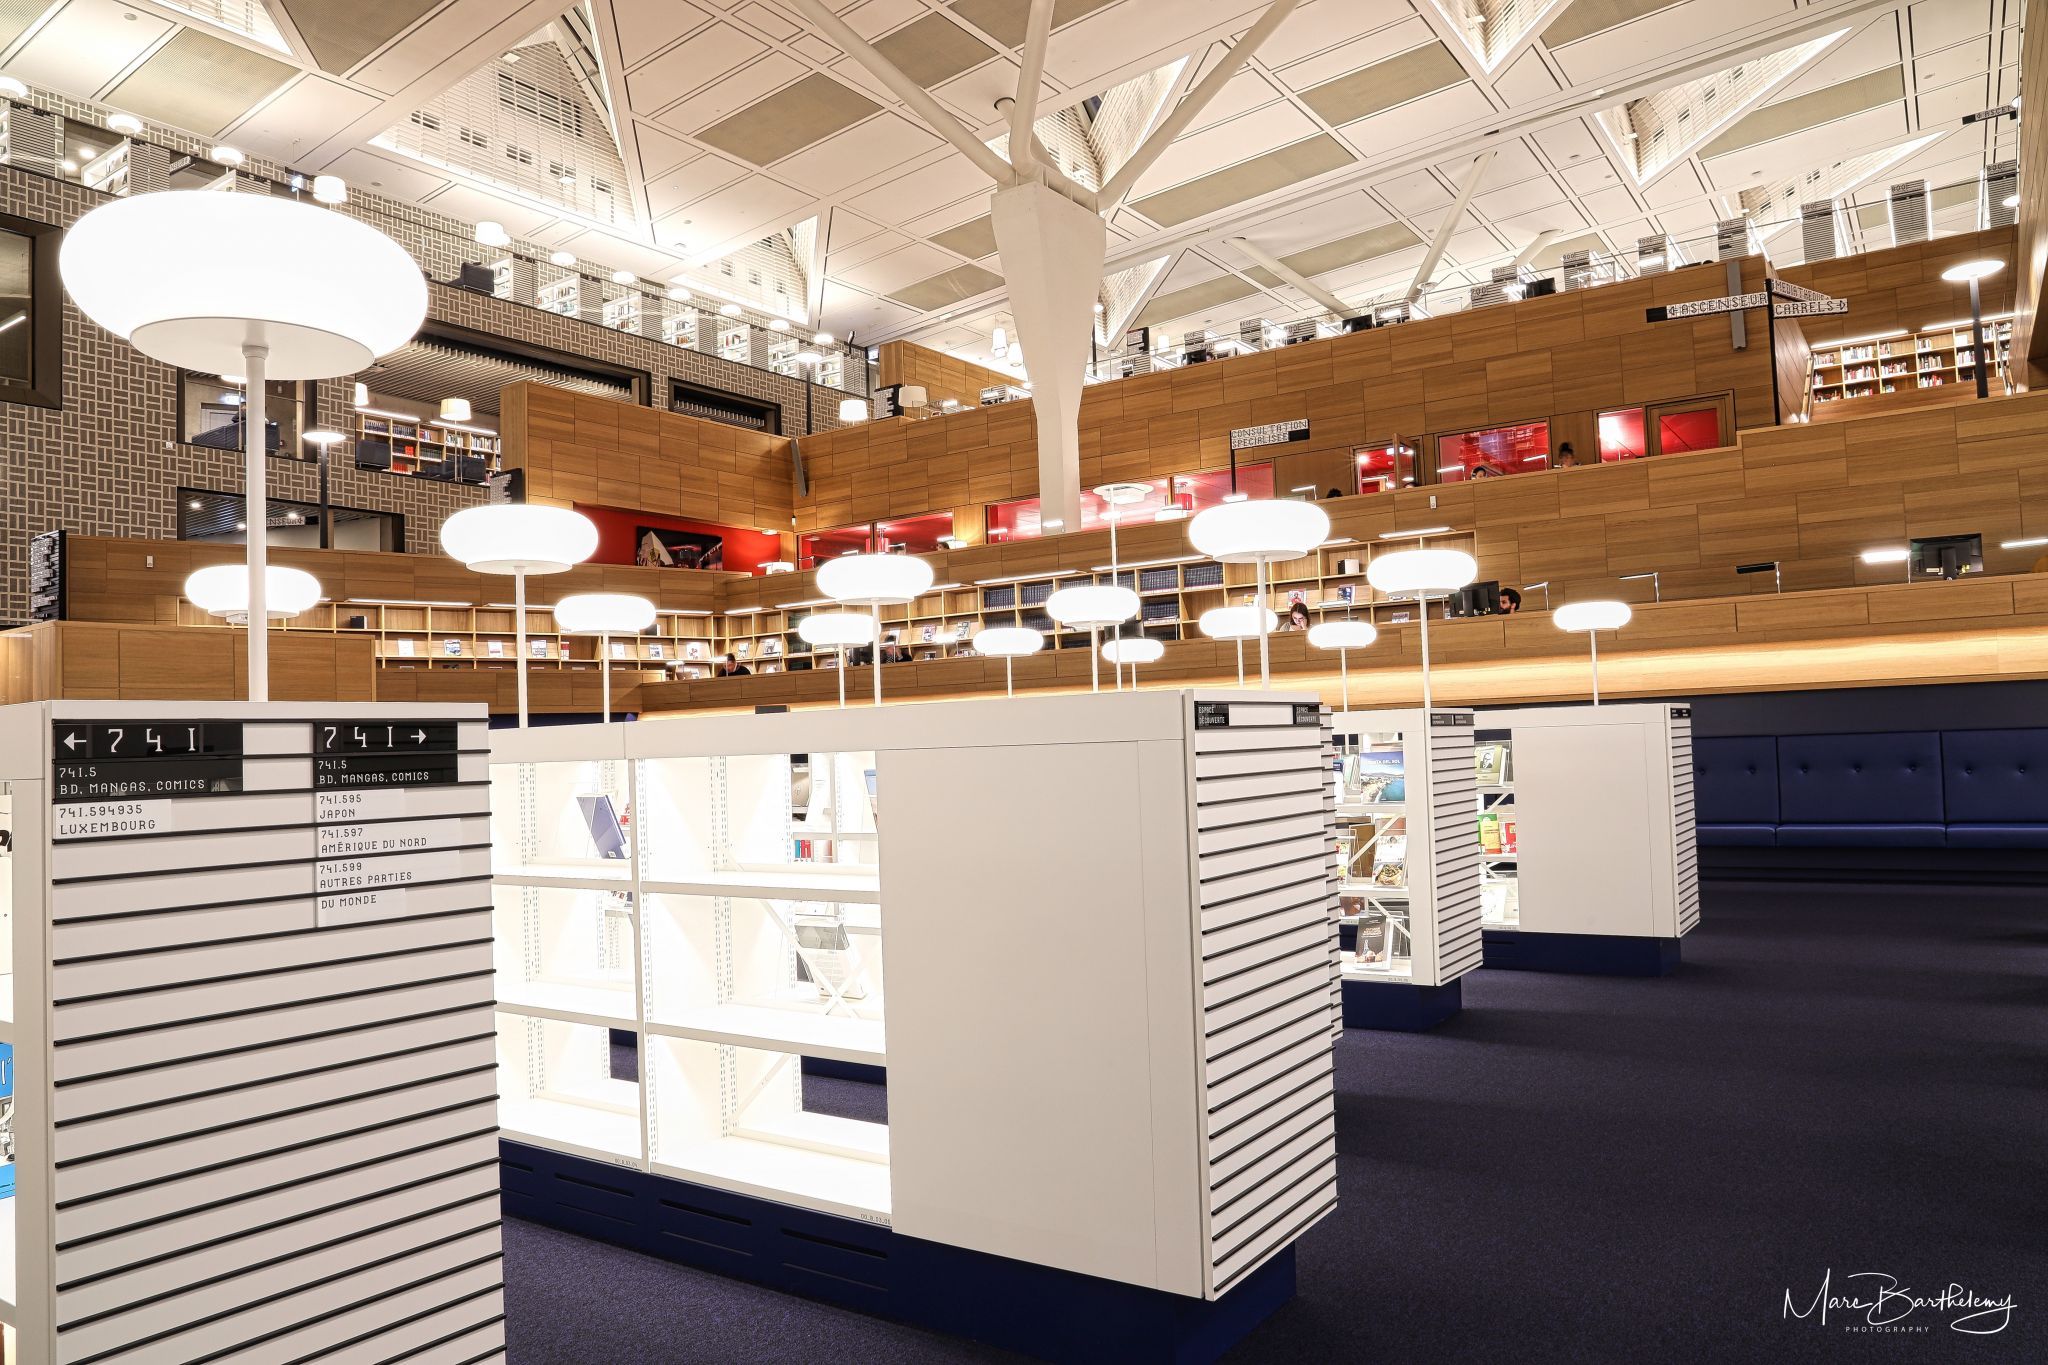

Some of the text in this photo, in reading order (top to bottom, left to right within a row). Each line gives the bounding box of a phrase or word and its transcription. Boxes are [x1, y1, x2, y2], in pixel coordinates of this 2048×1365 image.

[1681, 293, 1768, 315] ASCENSEUR
[1775, 300, 1834, 316] CARRELS
[1231, 419, 1307, 438] CONSULTATION
[318, 759, 347, 770] 741.5
[59, 766, 97, 778] 741.5
[391, 771, 429, 781] COMICS
[156, 779, 205, 791] COMICS
[319, 793, 362, 805] 741.595
[59, 804, 143, 819] 741.594935
[319, 808, 355, 820] JAPON
[60, 820, 156, 835] LUXEMBOURG
[321, 827, 363, 839] 741.597
[321, 837, 427, 854] AMÉRIQUE DU NORD
[319, 862, 362, 875] 741.599
[320, 871, 412, 889] AUTRES PARTIES
[321, 894, 377, 910] DU MONDE
